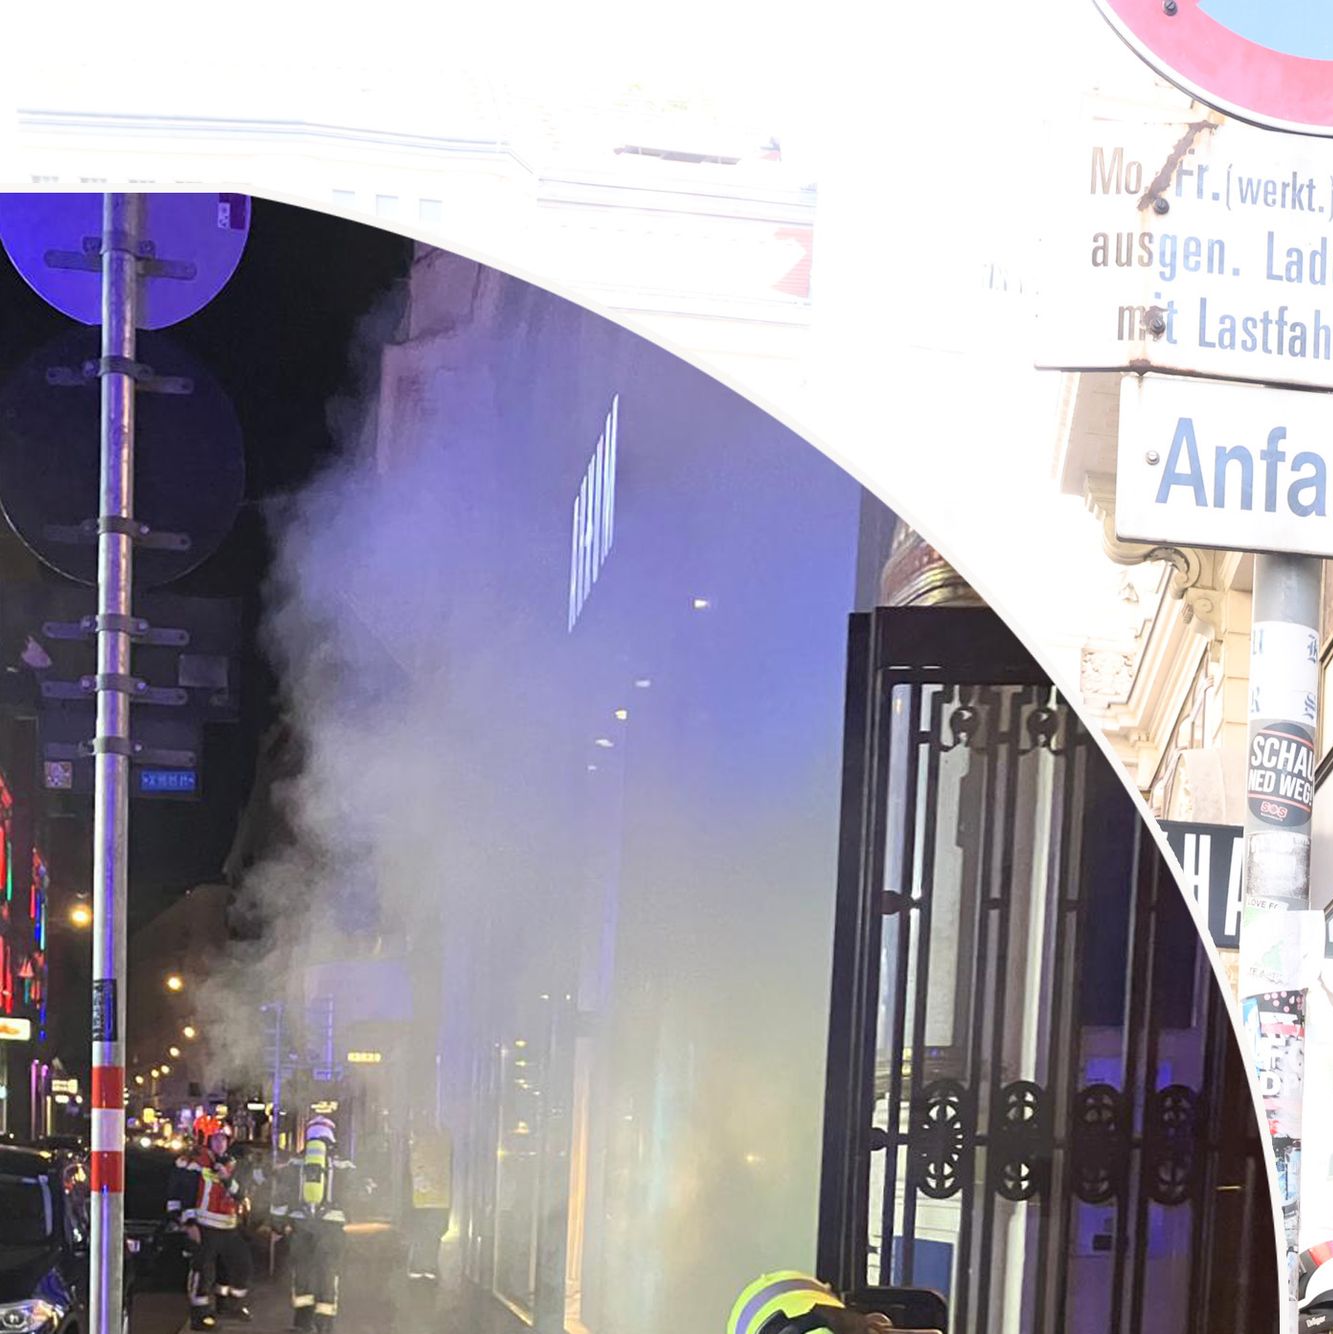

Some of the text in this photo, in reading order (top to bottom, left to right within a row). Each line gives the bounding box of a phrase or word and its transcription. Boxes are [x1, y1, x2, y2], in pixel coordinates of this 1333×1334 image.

[1091, 231, 1240, 281] ausgen.
[1251, 734, 1314, 780] SCHAU
[1248, 768, 1313, 806] NED WEG!
[1260, 801, 1288, 819] SOS
